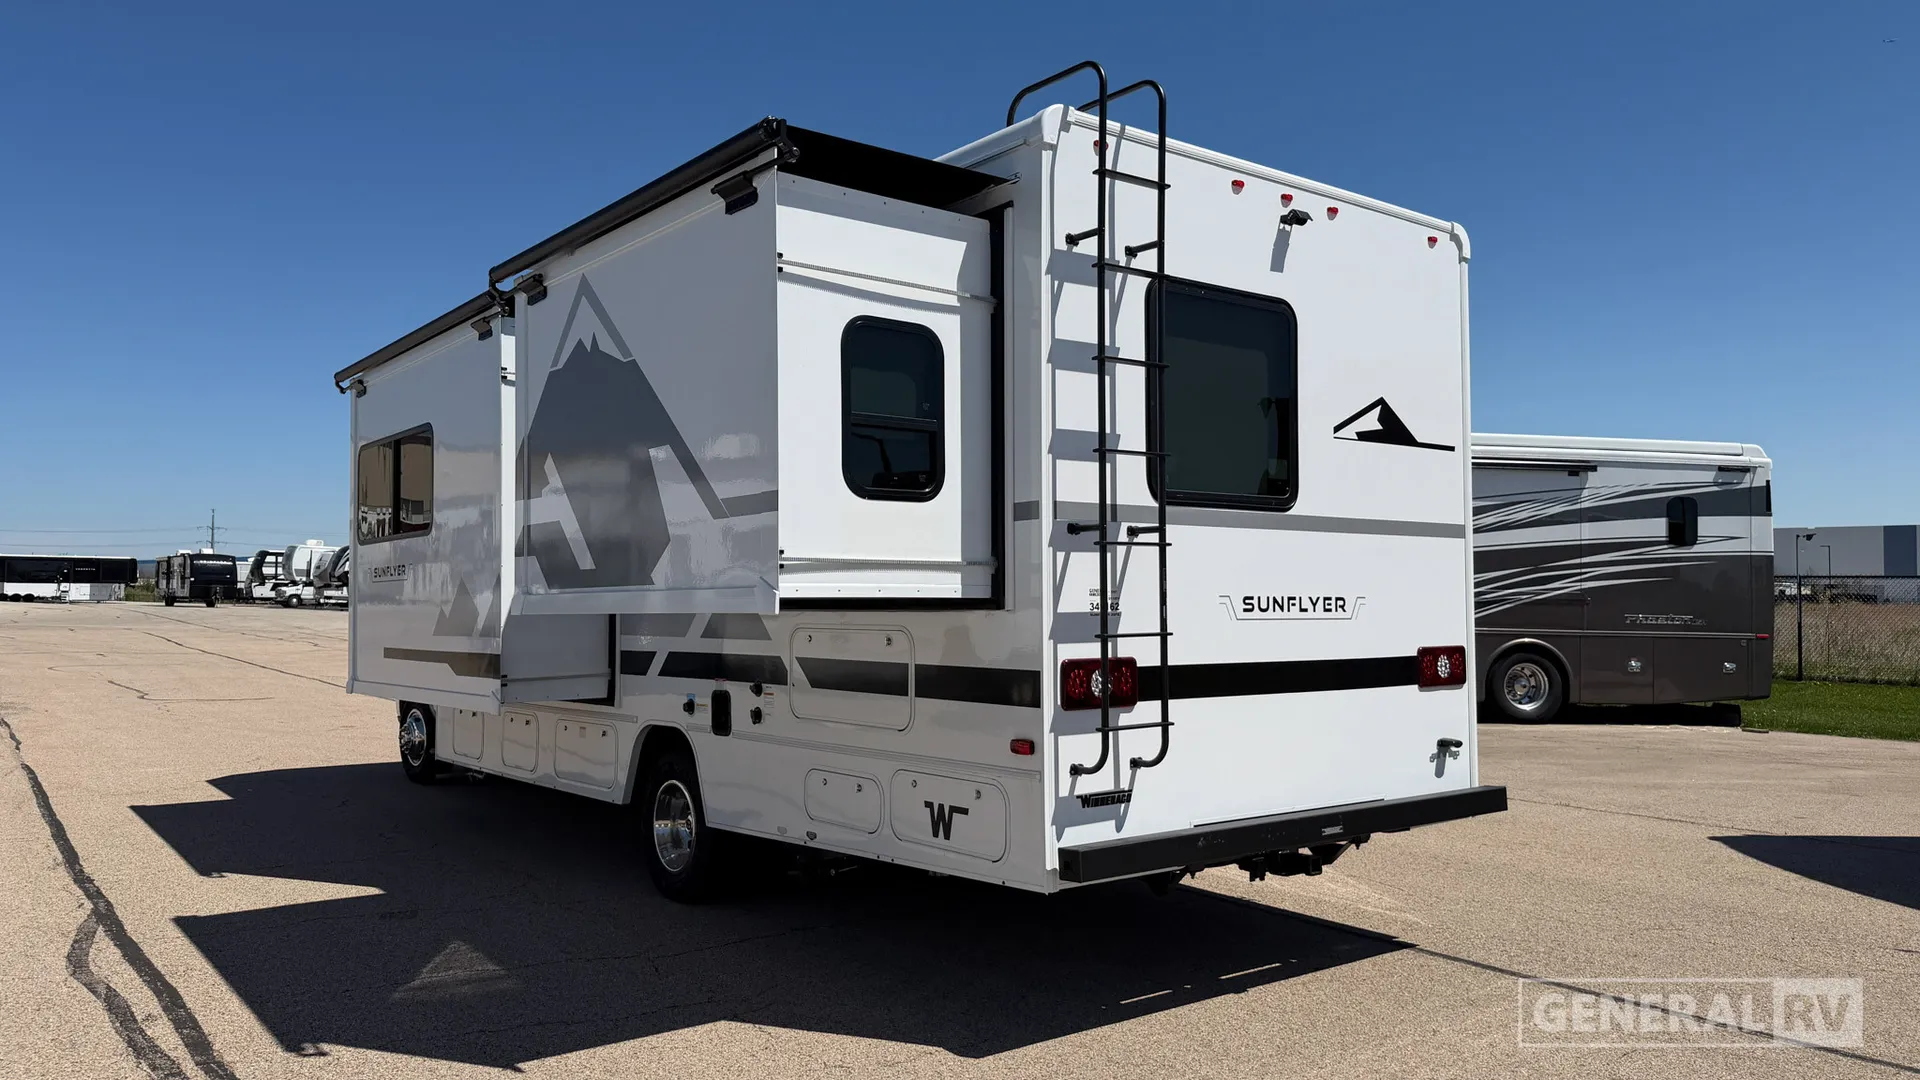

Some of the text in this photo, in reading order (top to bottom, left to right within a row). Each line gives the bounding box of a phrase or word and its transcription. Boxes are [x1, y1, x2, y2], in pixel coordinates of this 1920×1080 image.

[373, 564, 406, 578] SUNFLYER
[1089, 602, 1120, 611] 3462
[1242, 595, 1347, 613] SUNFLYER
[923, 800, 970, 841] W
